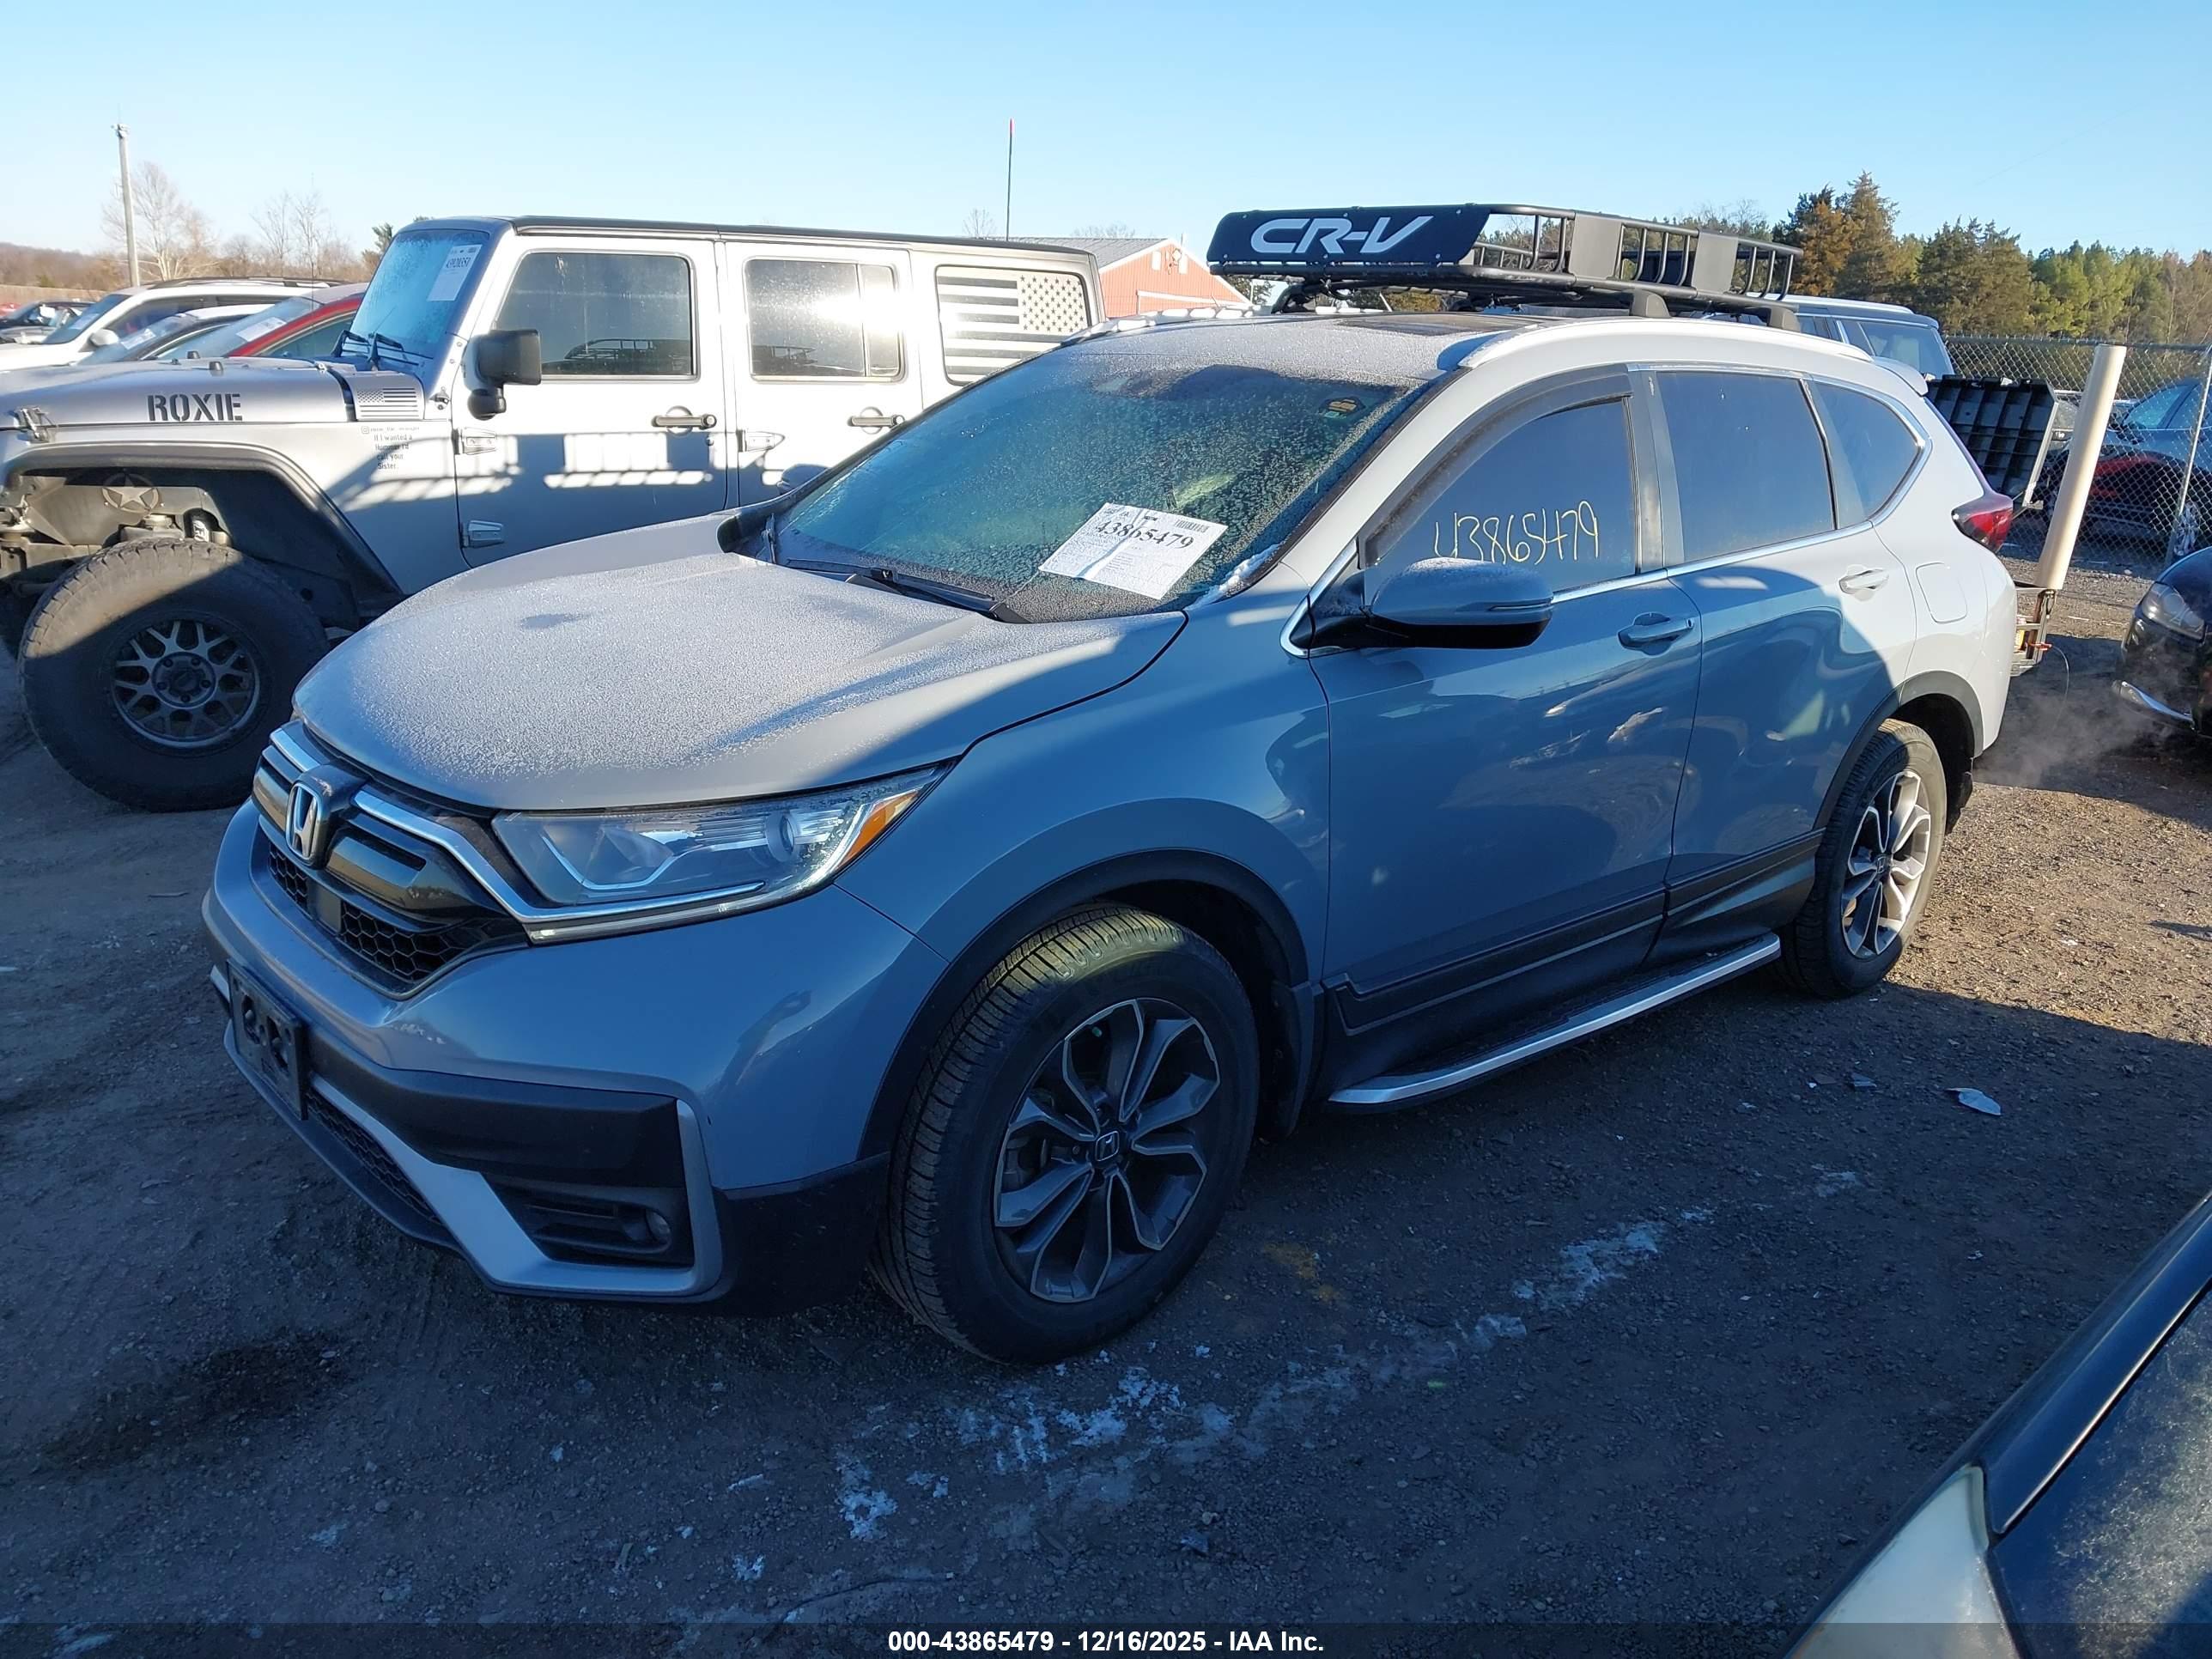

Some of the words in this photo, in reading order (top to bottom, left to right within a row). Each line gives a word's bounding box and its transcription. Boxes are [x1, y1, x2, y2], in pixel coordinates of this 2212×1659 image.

[1250, 216, 1434, 253] CR-V
[147, 393, 243, 421] ROXIE
[1095, 520, 1194, 550] 43865479
